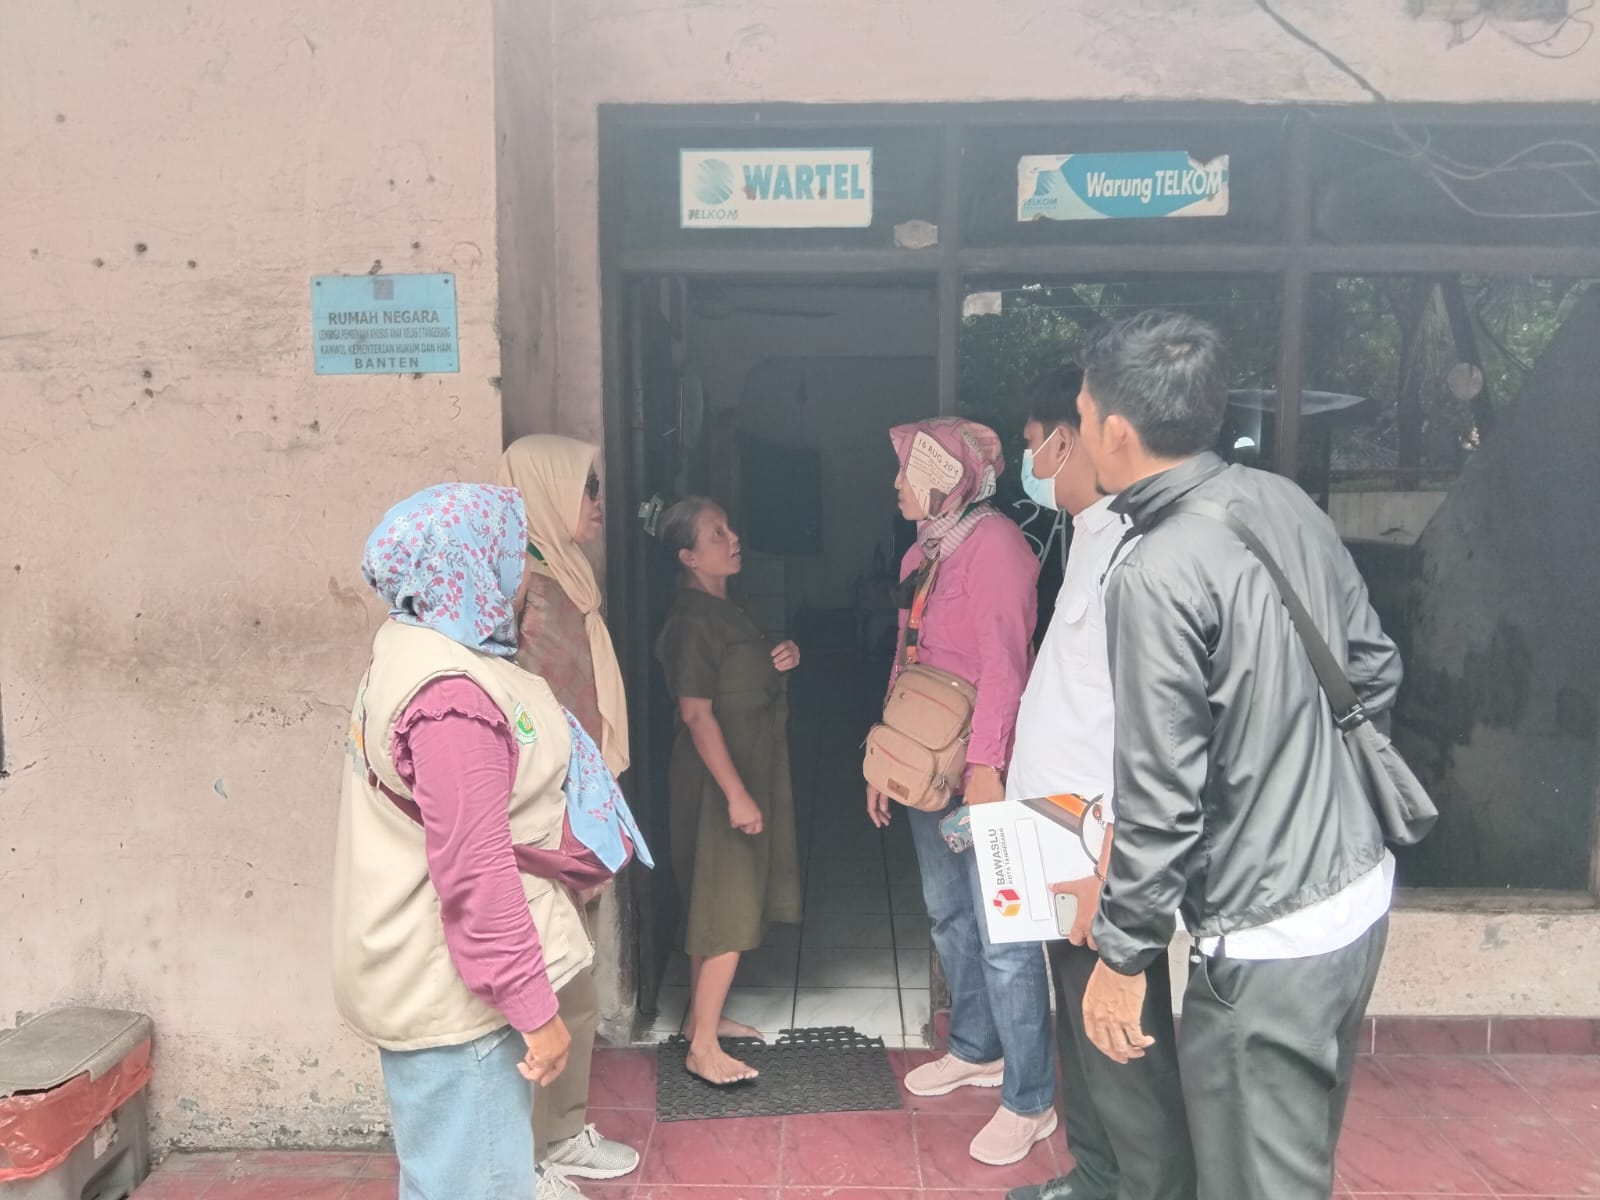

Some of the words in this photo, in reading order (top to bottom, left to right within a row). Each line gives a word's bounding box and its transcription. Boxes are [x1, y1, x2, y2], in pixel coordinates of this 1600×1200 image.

[742, 163, 865, 200] WARTEL
[1086, 172, 1153, 204] Warung
[1154, 168, 1222, 197] TELKOM
[687, 208, 738, 220] TELKOM
[328, 311, 378, 325] RUMAH
[383, 310, 439, 323] NEGARA
[320, 344, 346, 355] KANWIL
[348, 343, 394, 354] KEMENTERIAN
[396, 343, 420, 353] HUKUM
[421, 343, 436, 353] DAN
[437, 342, 451, 353] HAM
[355, 357, 419, 369] BANTEN
[928, 445, 942, 463] AUG
[988, 828, 1005, 885] BAWASLU
[1005, 866, 1013, 885] KOTA
